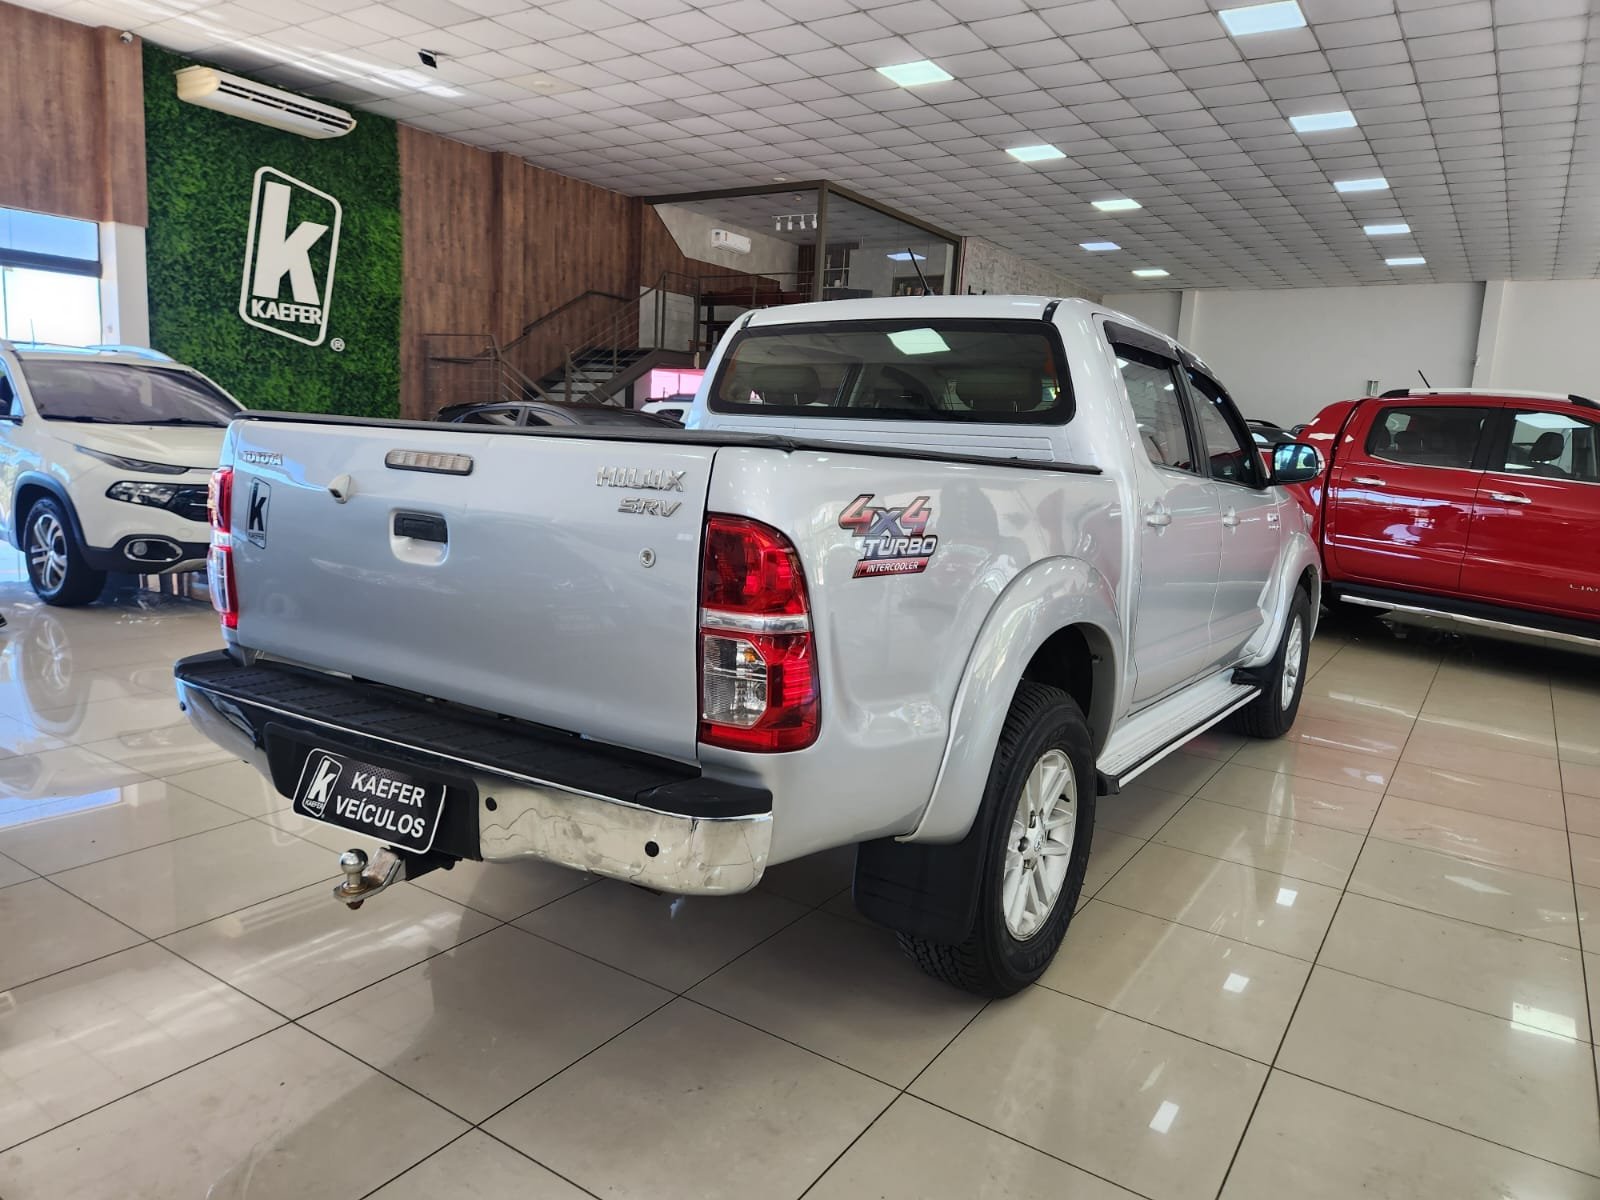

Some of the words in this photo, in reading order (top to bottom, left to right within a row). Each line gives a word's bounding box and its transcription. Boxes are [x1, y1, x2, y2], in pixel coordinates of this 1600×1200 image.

[252, 180, 329, 306] K
[251, 299, 323, 325] KAEFER
[595, 466, 687, 493] HILUX
[617, 496, 683, 518] SRV
[863, 535, 938, 560] TURBO
[866, 561, 919, 574] INTERCOOLER
[307, 760, 337, 802] K
[351, 771, 425, 808] KAEFER
[304, 799, 325, 809] KAEFER
[336, 795, 426, 838] VEÍCULOS
